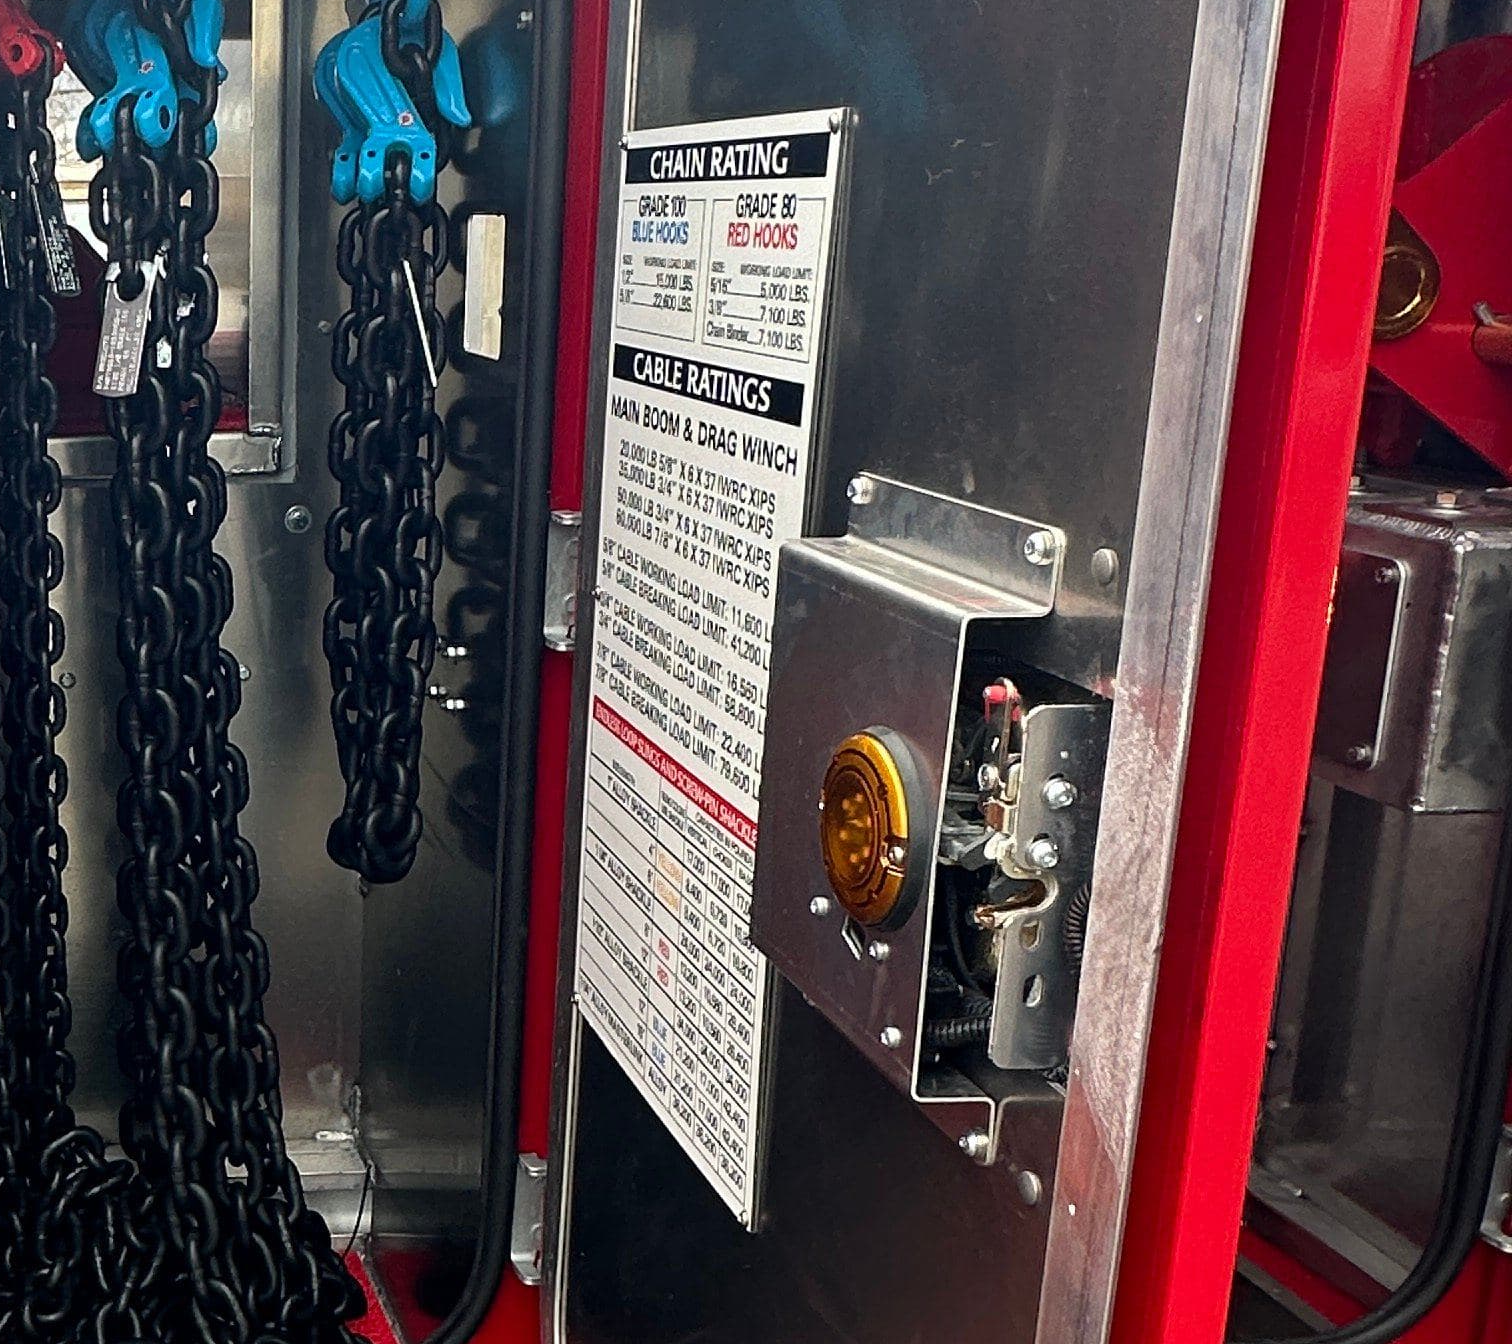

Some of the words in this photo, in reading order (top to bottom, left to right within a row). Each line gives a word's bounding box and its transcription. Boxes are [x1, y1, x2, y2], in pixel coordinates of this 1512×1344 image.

[649, 148, 709, 179] CHAIN
[709, 141, 789, 176] RATING
[638, 196, 669, 216] GRADE
[735, 194, 777, 217] GRADE
[780, 194, 796, 217] 80
[631, 221, 654, 241] BLUE
[655, 221, 689, 243] HOOKS
[727, 223, 750, 246] RED
[752, 223, 798, 249] HOOKS
[632, 353, 682, 387] CABLE
[686, 365, 771, 411] RATINGS
[611, 395, 639, 423] MAIN
[642, 404, 680, 437] BOOM
[683, 416, 693, 441] &
[697, 421, 737, 456] DRAG
[741, 434, 798, 476] WINCH
[679, 460, 686, 480] X
[694, 466, 702, 486] X
[703, 469, 715, 491] 37
[748, 486, 775, 514] XIPS
[677, 483, 685, 502] X
[693, 489, 700, 509] X
[702, 493, 714, 515] 37
[746, 510, 773, 540] XIPS
[675, 512, 683, 531] X
[691, 518, 698, 538] X
[700, 522, 712, 544] 37
[744, 542, 771, 572] XIPS
[674, 535, 681, 555] X
[689, 542, 697, 563] X
[698, 547, 710, 570] 37
[742, 567, 769, 599] XIPS
[677, 576, 700, 604] LOAD
[678, 601, 700, 630] LOAD
[673, 635, 695, 666] LOAD
[672, 658, 694, 689] LOAD
[669, 692, 691, 724] LOAD
[668, 716, 690, 750] LOAD
